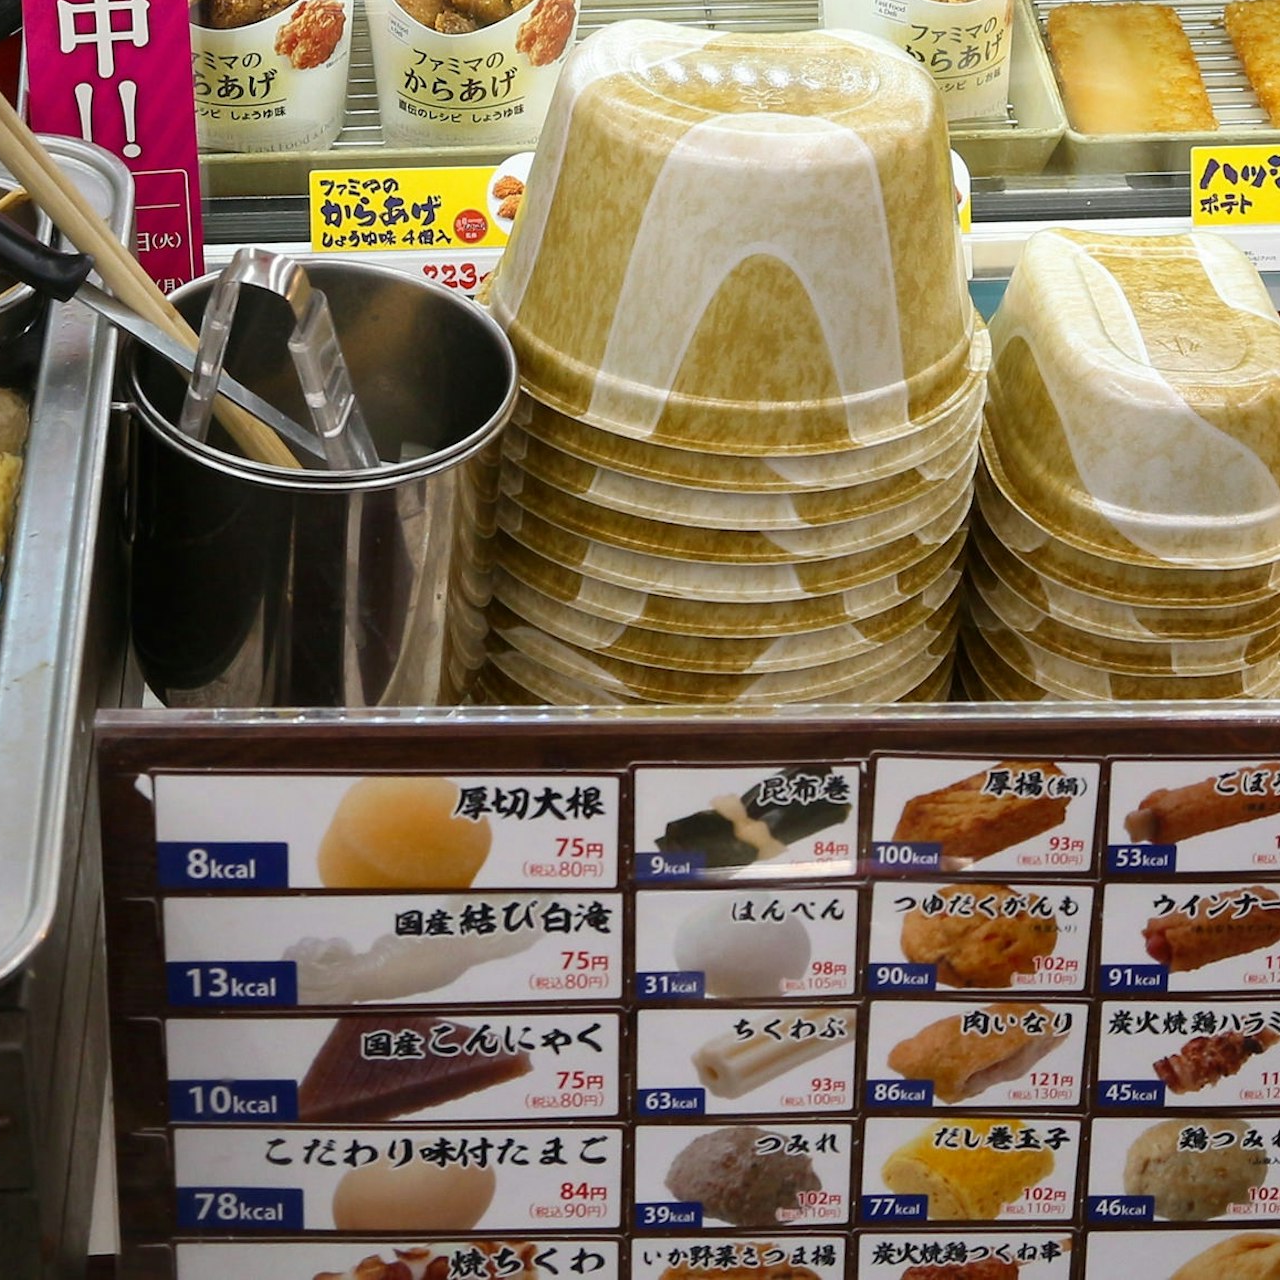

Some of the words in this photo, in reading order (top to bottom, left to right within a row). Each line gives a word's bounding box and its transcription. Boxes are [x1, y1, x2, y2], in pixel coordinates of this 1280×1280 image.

[910, 15, 998, 44] ファミマの
[412, 48, 505, 75] ファミマの
[404, 67, 518, 103] からあげ
[319, 178, 400, 196] ファミマの
[320, 194, 442, 228] からあげ
[1200, 194, 1253, 215] ポテト
[321, 231, 397, 248] しょうゆ味
[402, 228, 452, 246] 4個入
[756, 774, 851, 807] 昆布巻
[453, 786, 606, 820] 厚切大根
[555, 837, 604, 859] 75円
[1048, 837, 1085, 852] 93円
[186, 848, 256, 880] 8kcal
[877, 846, 939, 866] 100kcal
[1115, 848, 1169, 868] 53kcal
[394, 900, 613, 937] 国産結び白滝
[731, 898, 845, 922] はんぺん
[561, 951, 609, 971] 75円
[811, 961, 848, 976] 98円
[1033, 957, 1079, 973] 102円
[186, 968, 276, 998] 13kcal
[644, 976, 698, 994] 31kcal
[876, 967, 929, 986] 90kcal
[1108, 967, 1162, 988] 91kcal
[733, 1018, 847, 1041] ちくわぶ
[961, 1011, 1074, 1034] 肉いなり
[361, 1023, 604, 1059] 国産こんにゃく
[556, 1071, 604, 1090] 75円
[811, 1078, 846, 1092] 93円
[1029, 1073, 1074, 1087] 121円
[188, 1086, 277, 1115] 10kcal
[645, 1091, 698, 1109] 63kcal
[874, 1084, 927, 1102] 86kcal
[1104, 1083, 1159, 1102] 45kcal
[264, 1135, 609, 1167] こだわり味付たまご
[755, 1133, 840, 1155] つみれ
[560, 1182, 607, 1201] 84円
[1022, 1187, 1068, 1202] 102円
[194, 1192, 284, 1221] 78kcal
[643, 1206, 695, 1224] 39kcal
[869, 1199, 921, 1217] 77kcal
[1095, 1198, 1148, 1217] 46kcal
[451, 1248, 605, 1279] 焼ちくわ
[643, 1243, 837, 1268] いか野菜さつま揚
[871, 1241, 1064, 1266] 炭火焼鶏つくね串
